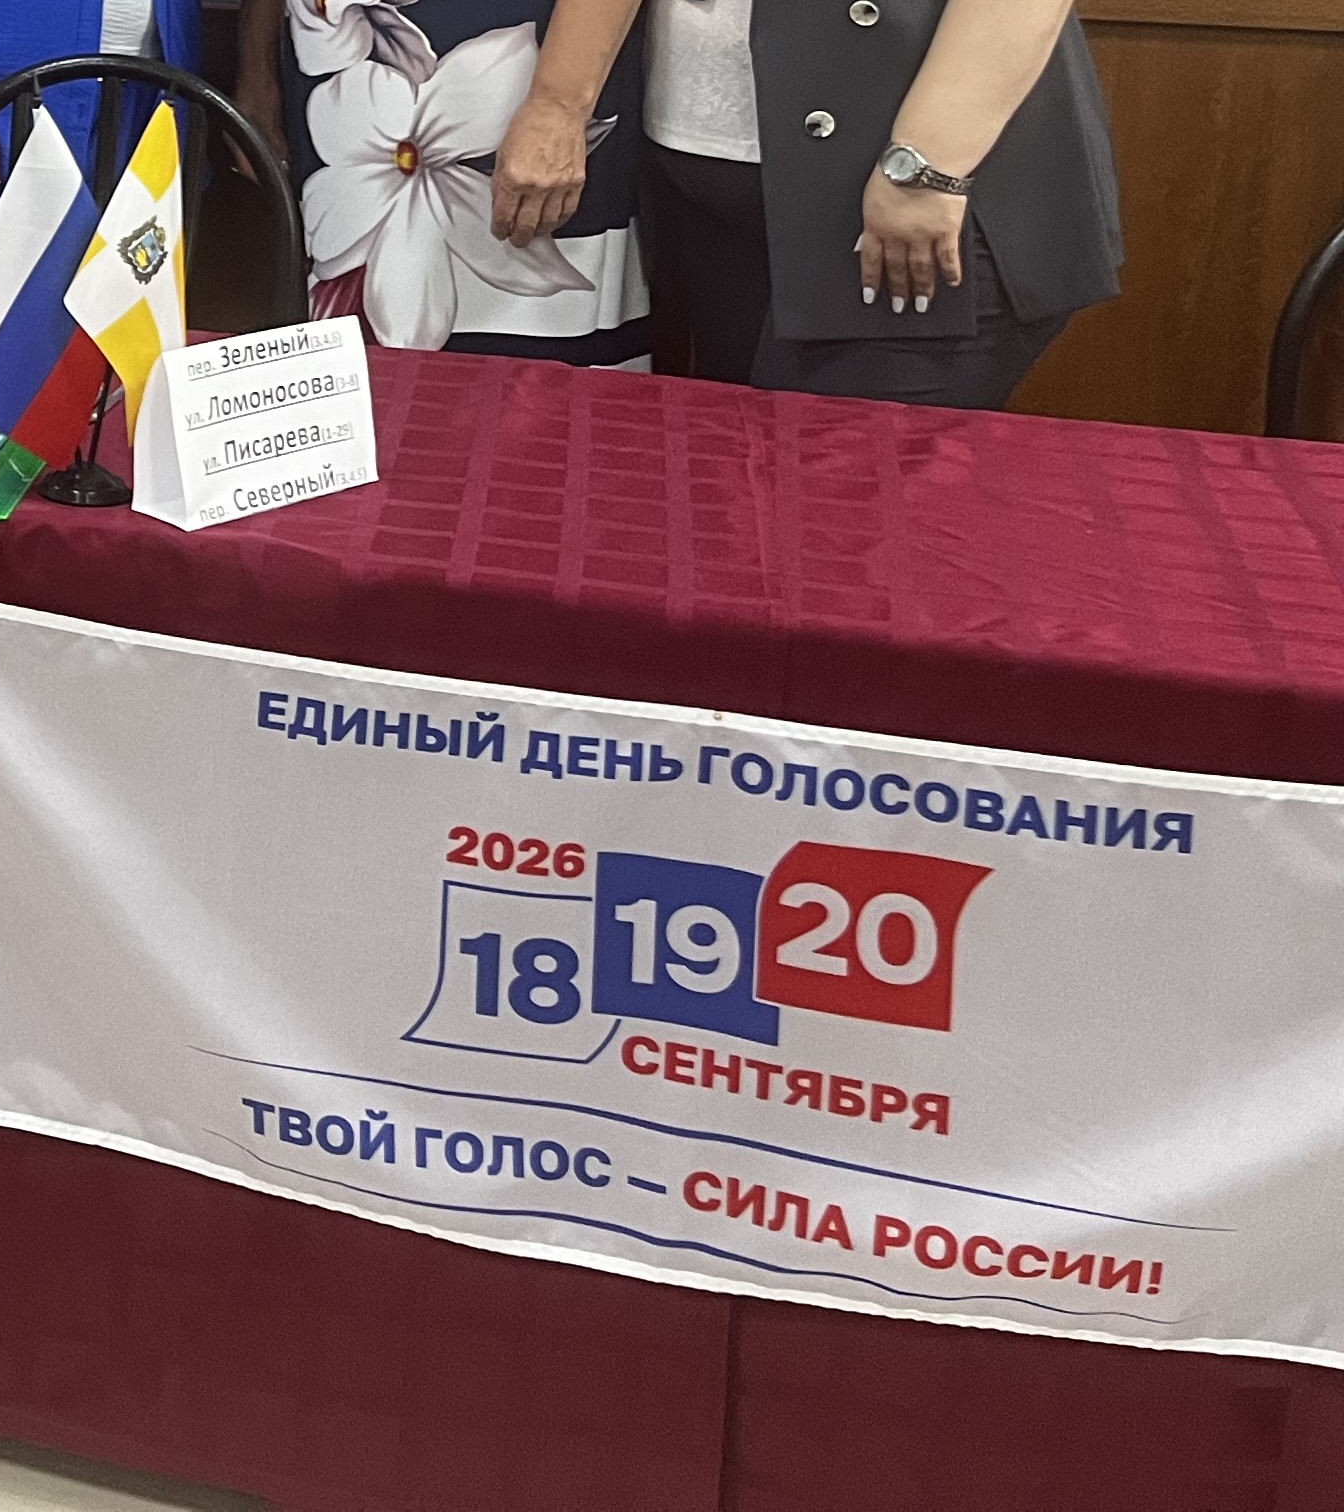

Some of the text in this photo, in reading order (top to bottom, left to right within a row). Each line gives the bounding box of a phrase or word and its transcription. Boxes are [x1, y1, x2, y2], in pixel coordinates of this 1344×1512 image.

[188, 360, 216, 378] пер.
[200, 507, 230, 523] пер.
[256, 691, 1196, 855] ЕДИНЫЙ ДЕНЬ ГОЛОСОВАНИЯ
[446, 825, 587, 880] 2026
[458, 880, 942, 1026] 18 19 20
[619, 1036, 953, 1138] СЕНТЯБРЯ
[241, 1097, 399, 1166] ТВОЙ
[414, 1125, 614, 1190] ГОЛОС
[682, 1169, 854, 1254] СИЛА
[873, 1213, 1167, 1297] РОССИИ!
